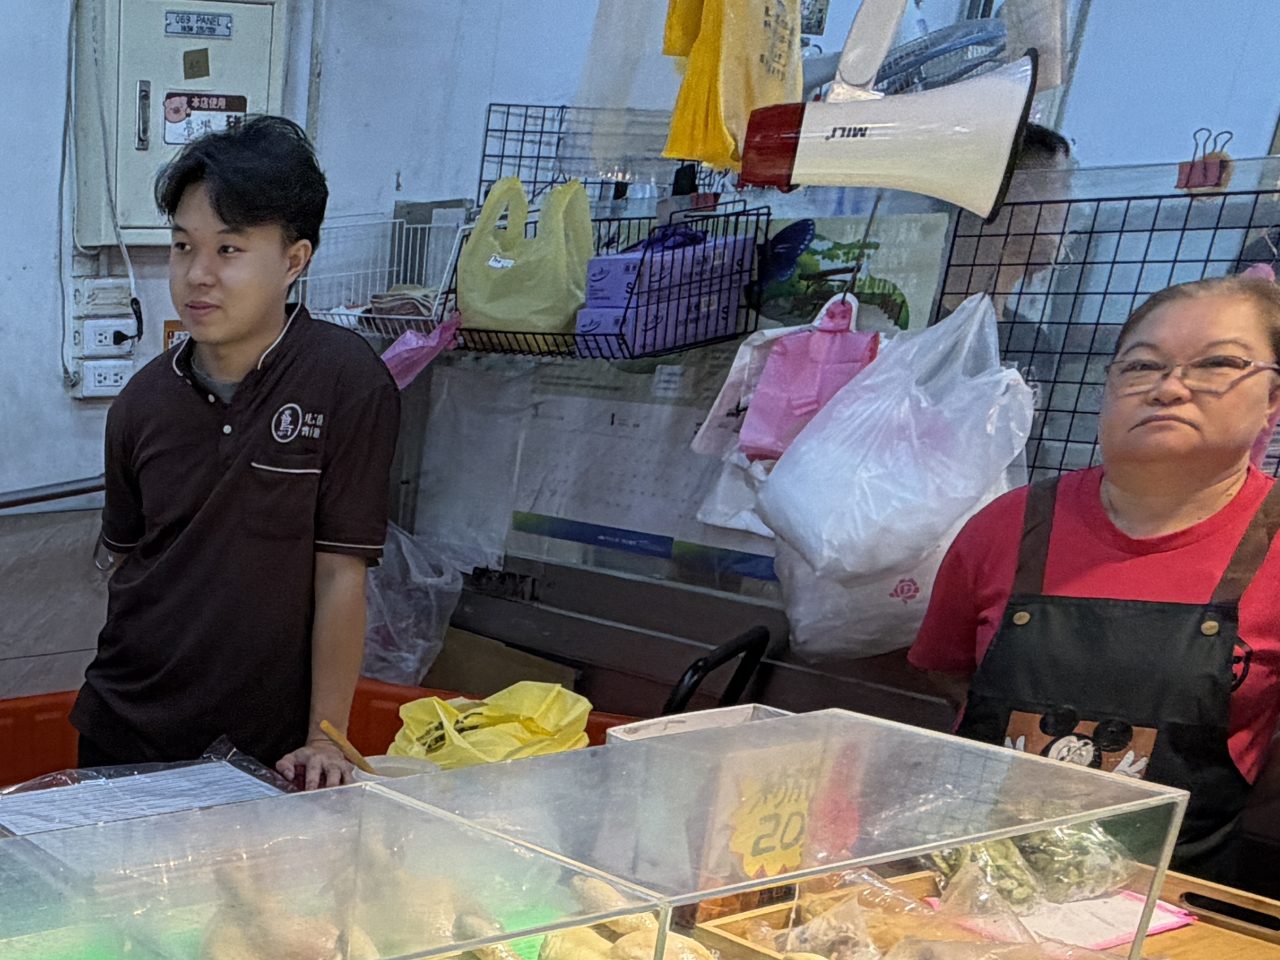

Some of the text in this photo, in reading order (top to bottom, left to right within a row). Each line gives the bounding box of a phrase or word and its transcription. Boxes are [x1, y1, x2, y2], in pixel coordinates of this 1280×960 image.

[196, 16, 222, 27] PANEL
[191, 97, 227, 110] 本店使用
[751, 811, 806, 857] 20
